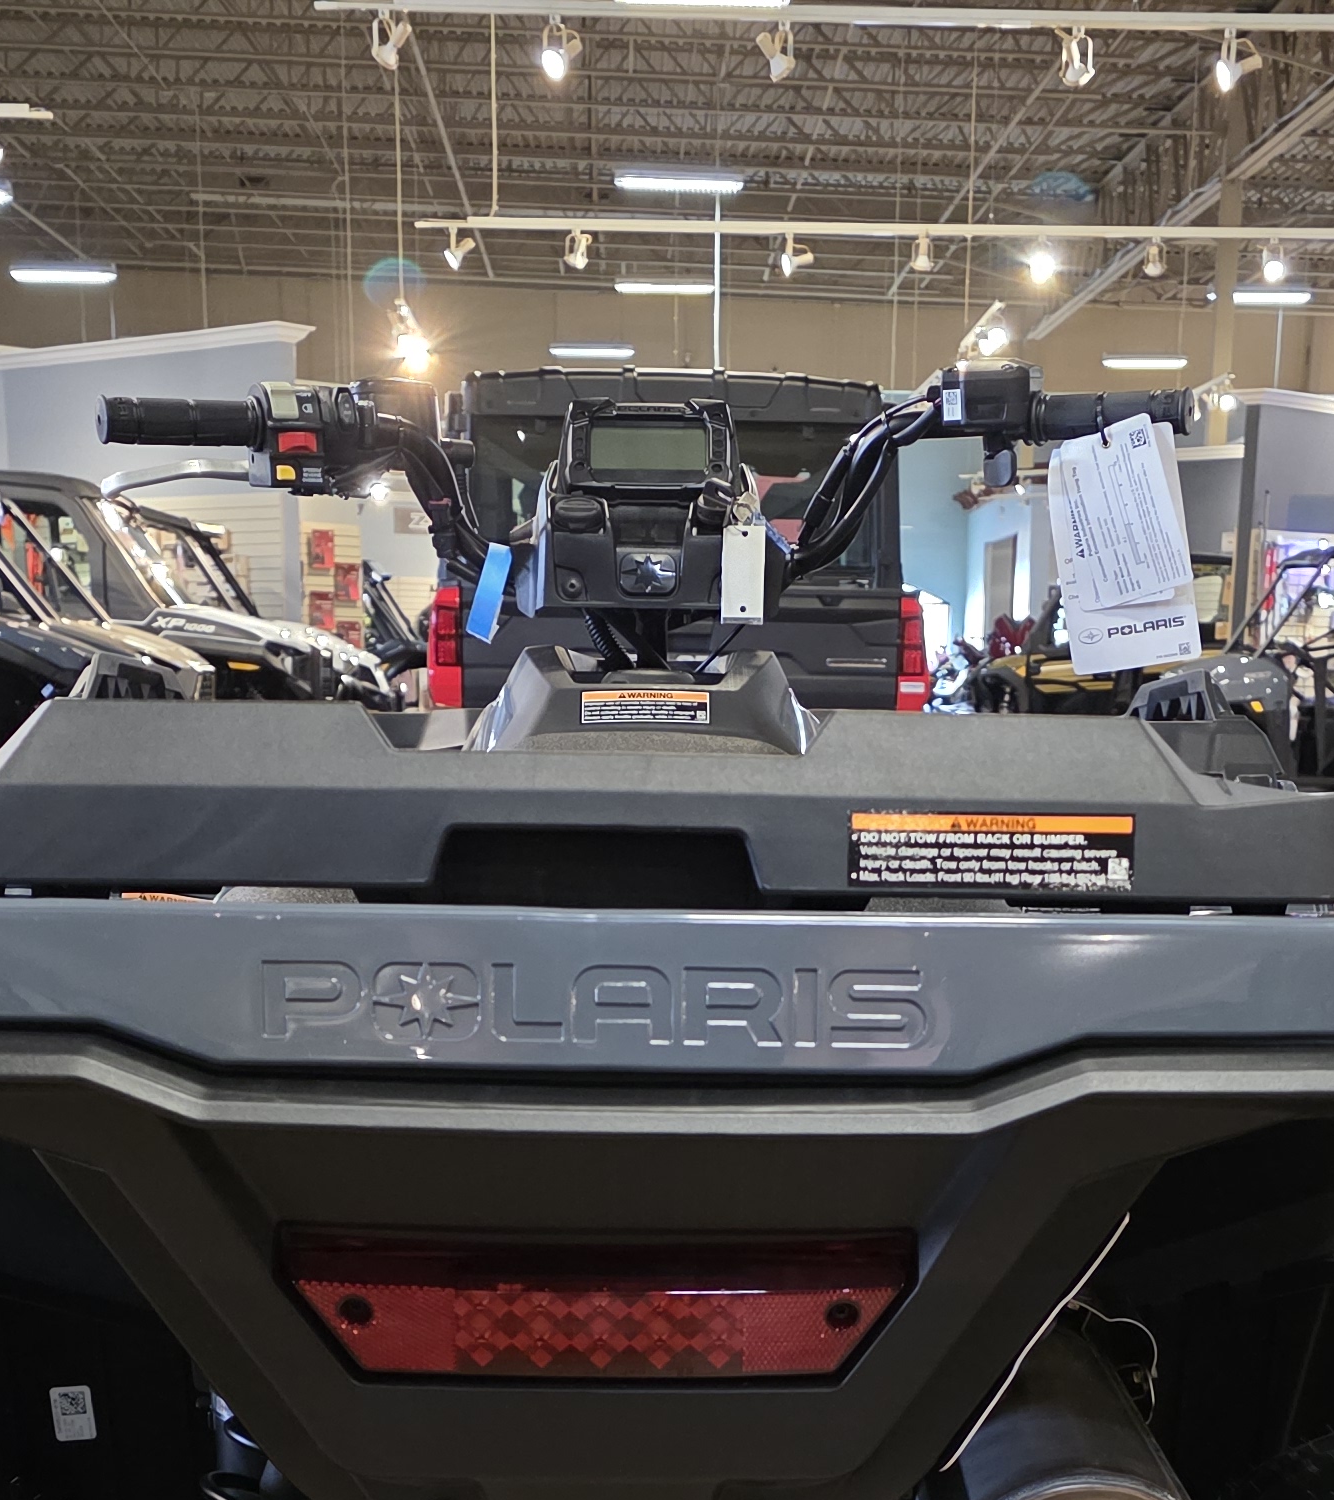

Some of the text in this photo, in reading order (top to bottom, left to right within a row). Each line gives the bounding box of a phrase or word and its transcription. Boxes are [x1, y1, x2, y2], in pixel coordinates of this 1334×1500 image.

[151, 616, 216, 633] XP 1000
[1107, 616, 1185, 638] POLARIS
[966, 818, 1036, 829] WARNING
[860, 832, 1088, 845] DO NOT TOW FROM RACK OR BUMPER.
[859, 845, 897, 856] Vehicle
[897, 846, 939, 858] damage
[940, 848, 951, 856] or
[1013, 848, 1042, 858] result
[1043, 848, 1083, 860] causing
[1083, 850, 1117, 858] severe
[888, 860, 901, 869] or
[935, 858, 957, 870] Tow
[959, 860, 981, 871] only
[982, 860, 1006, 870] from
[1007, 860, 1027, 870] tow
[1027, 860, 1059, 870] hooks
[1060, 862, 1073, 870] or
[261, 960, 930, 1048] POLARIS
